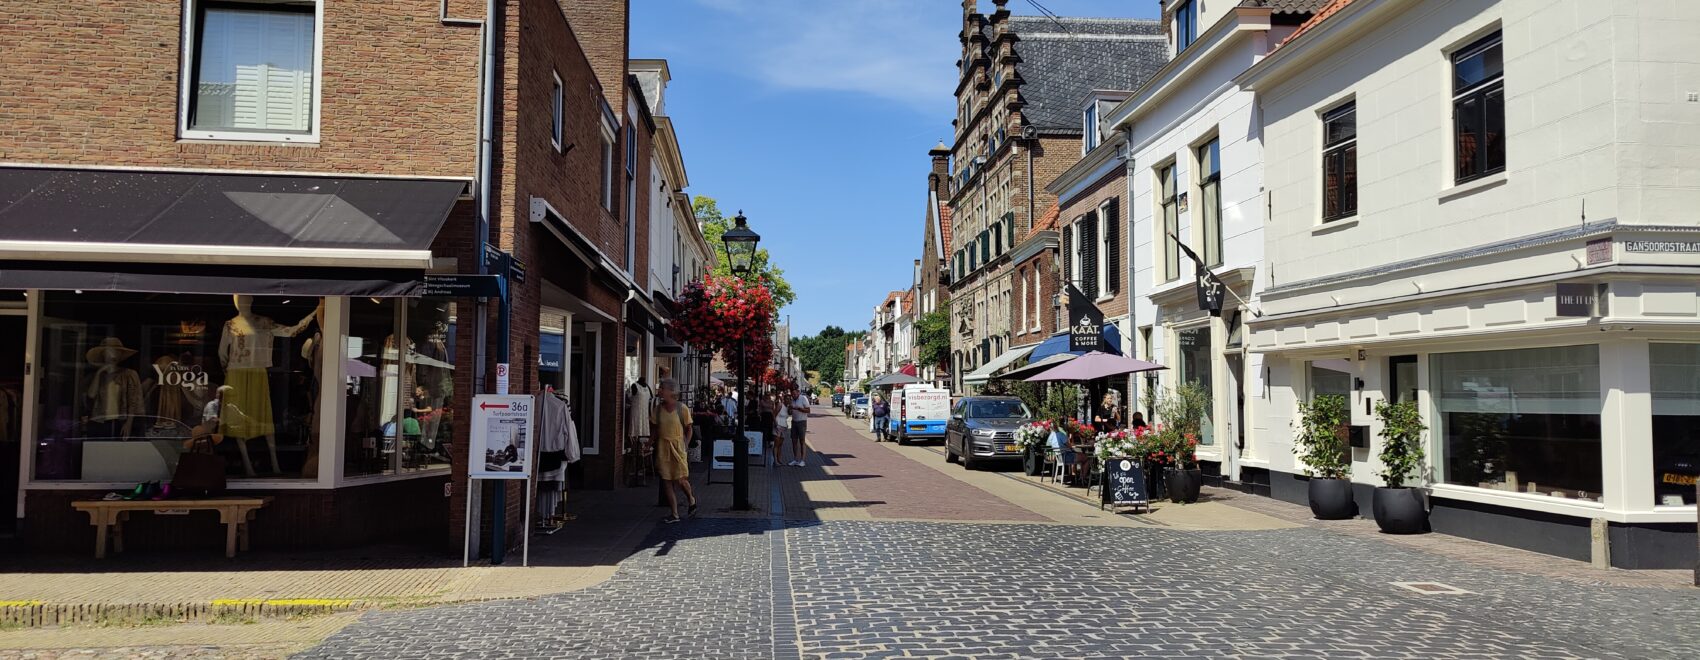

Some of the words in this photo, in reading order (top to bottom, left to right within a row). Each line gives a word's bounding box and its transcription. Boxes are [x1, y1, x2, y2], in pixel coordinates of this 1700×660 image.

[1627, 242, 1700, 252] GANSOORDSTRAAT
[1561, 296, 1575, 305] THE
[1071, 325, 1101, 335] KAAT.
[152, 361, 209, 392] Yoga
[908, 394, 948, 402] visbezorgd.nl
[511, 401, 529, 412] 36a
[1118, 476, 1135, 488] open
